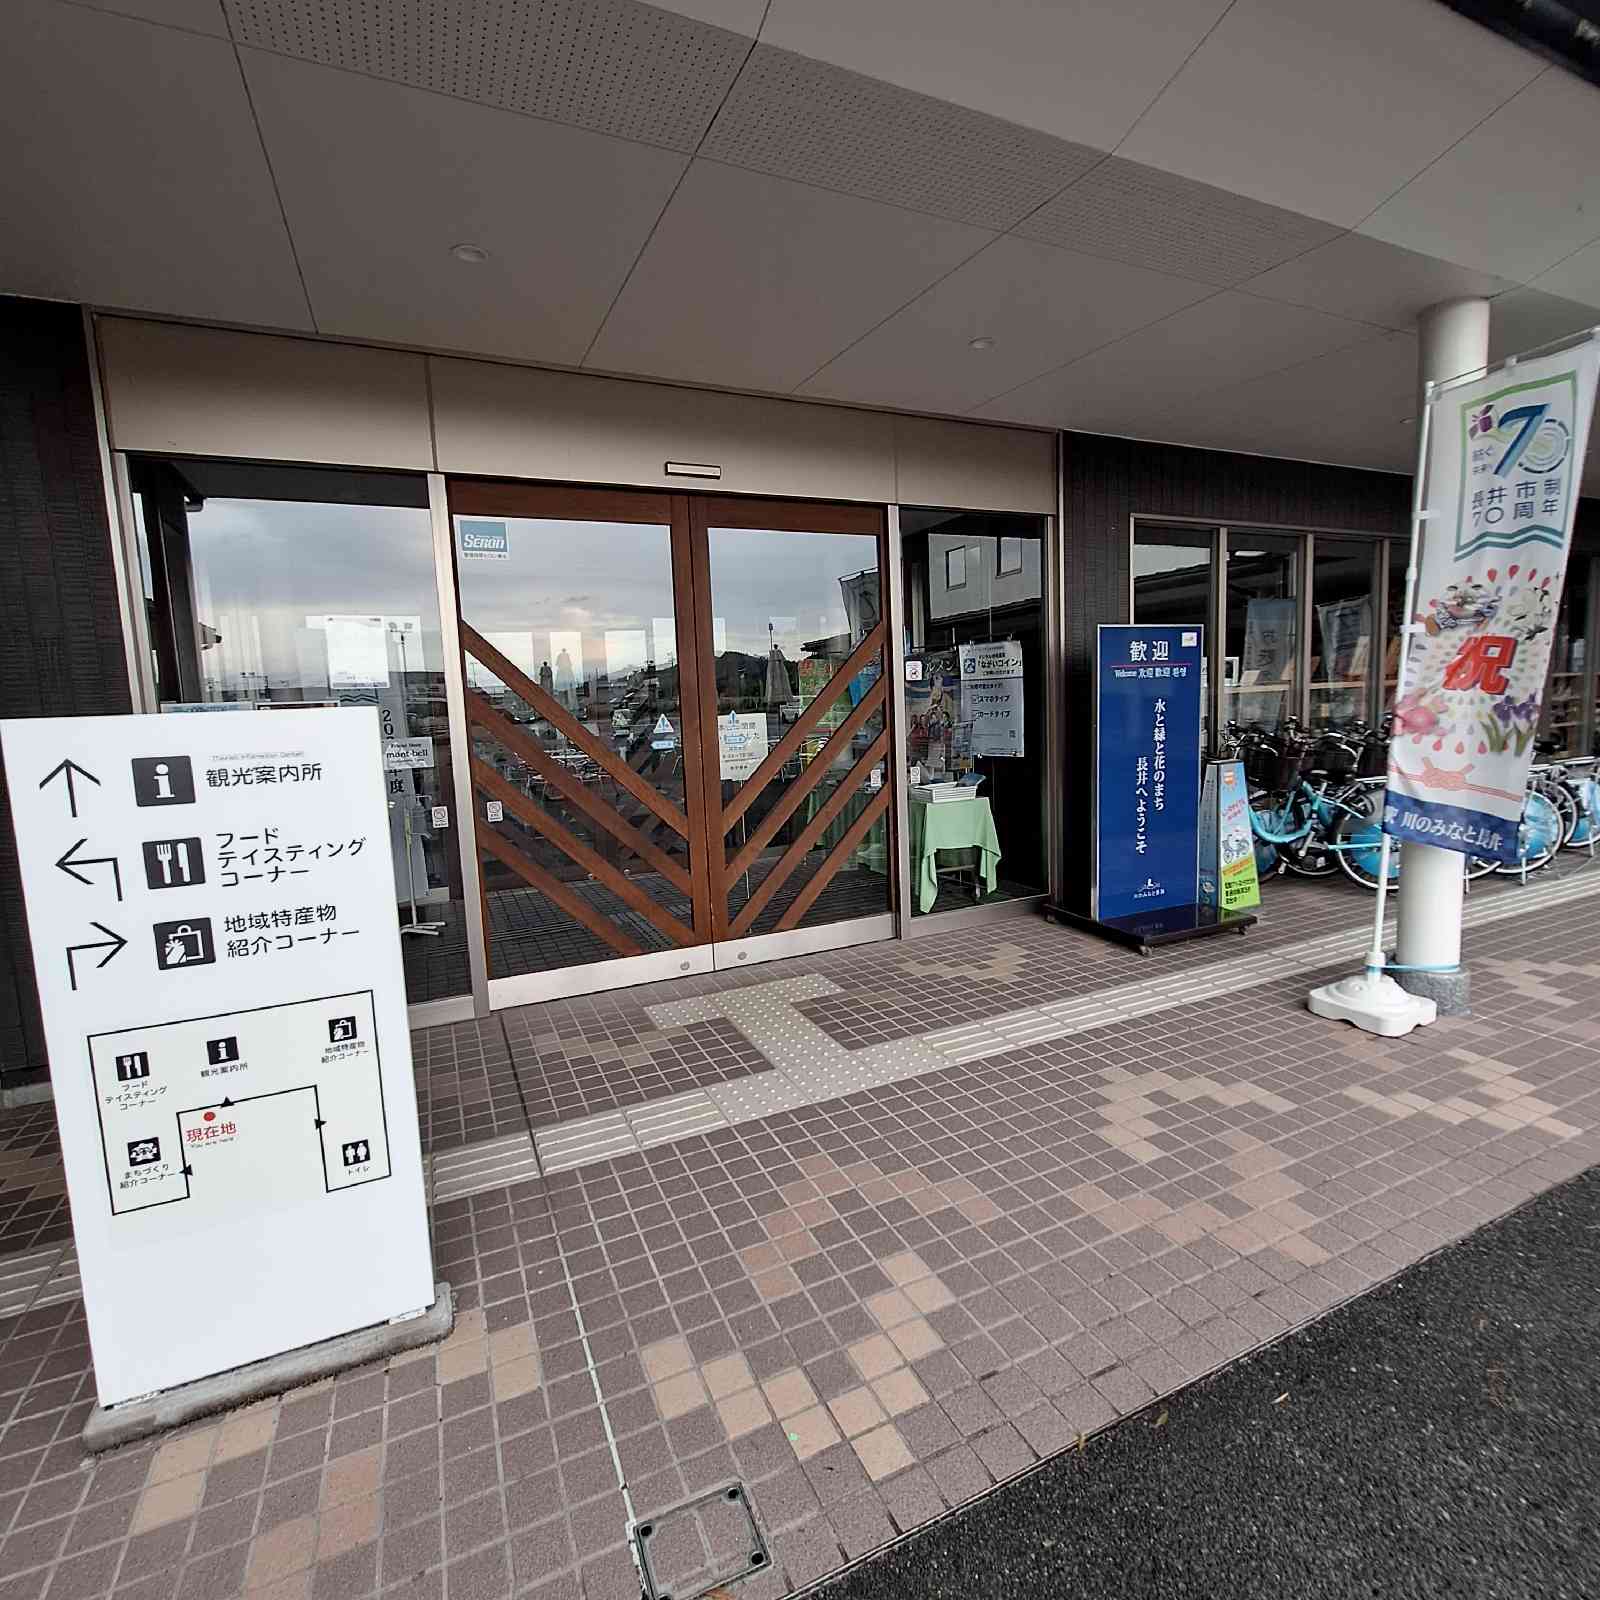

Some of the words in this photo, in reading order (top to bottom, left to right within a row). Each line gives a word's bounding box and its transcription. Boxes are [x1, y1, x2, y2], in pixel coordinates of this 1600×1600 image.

[1129, 640, 1169, 662] 歓迎
[1442, 635, 1518, 695] 祝
[1153, 698, 1167, 811] 水と緑と花のまち
[206, 763, 322, 788] 観光案内所
[1135, 757, 1149, 854] 長井へようこそ
[216, 828, 280, 849] フード
[217, 837, 367, 868] テイスティング
[222, 866, 310, 887] コーナー
[224, 903, 337, 933] 地域特産物
[227, 930, 360, 958] 紹介コーナー
[200, 1062, 248, 1078] 観光案内所
[120, 1099, 157, 1111] コーナー
[186, 1121, 236, 1143] 現在地
[124, 1164, 169, 1179] まちづくり
[348, 1166, 370, 1176] トイレ
